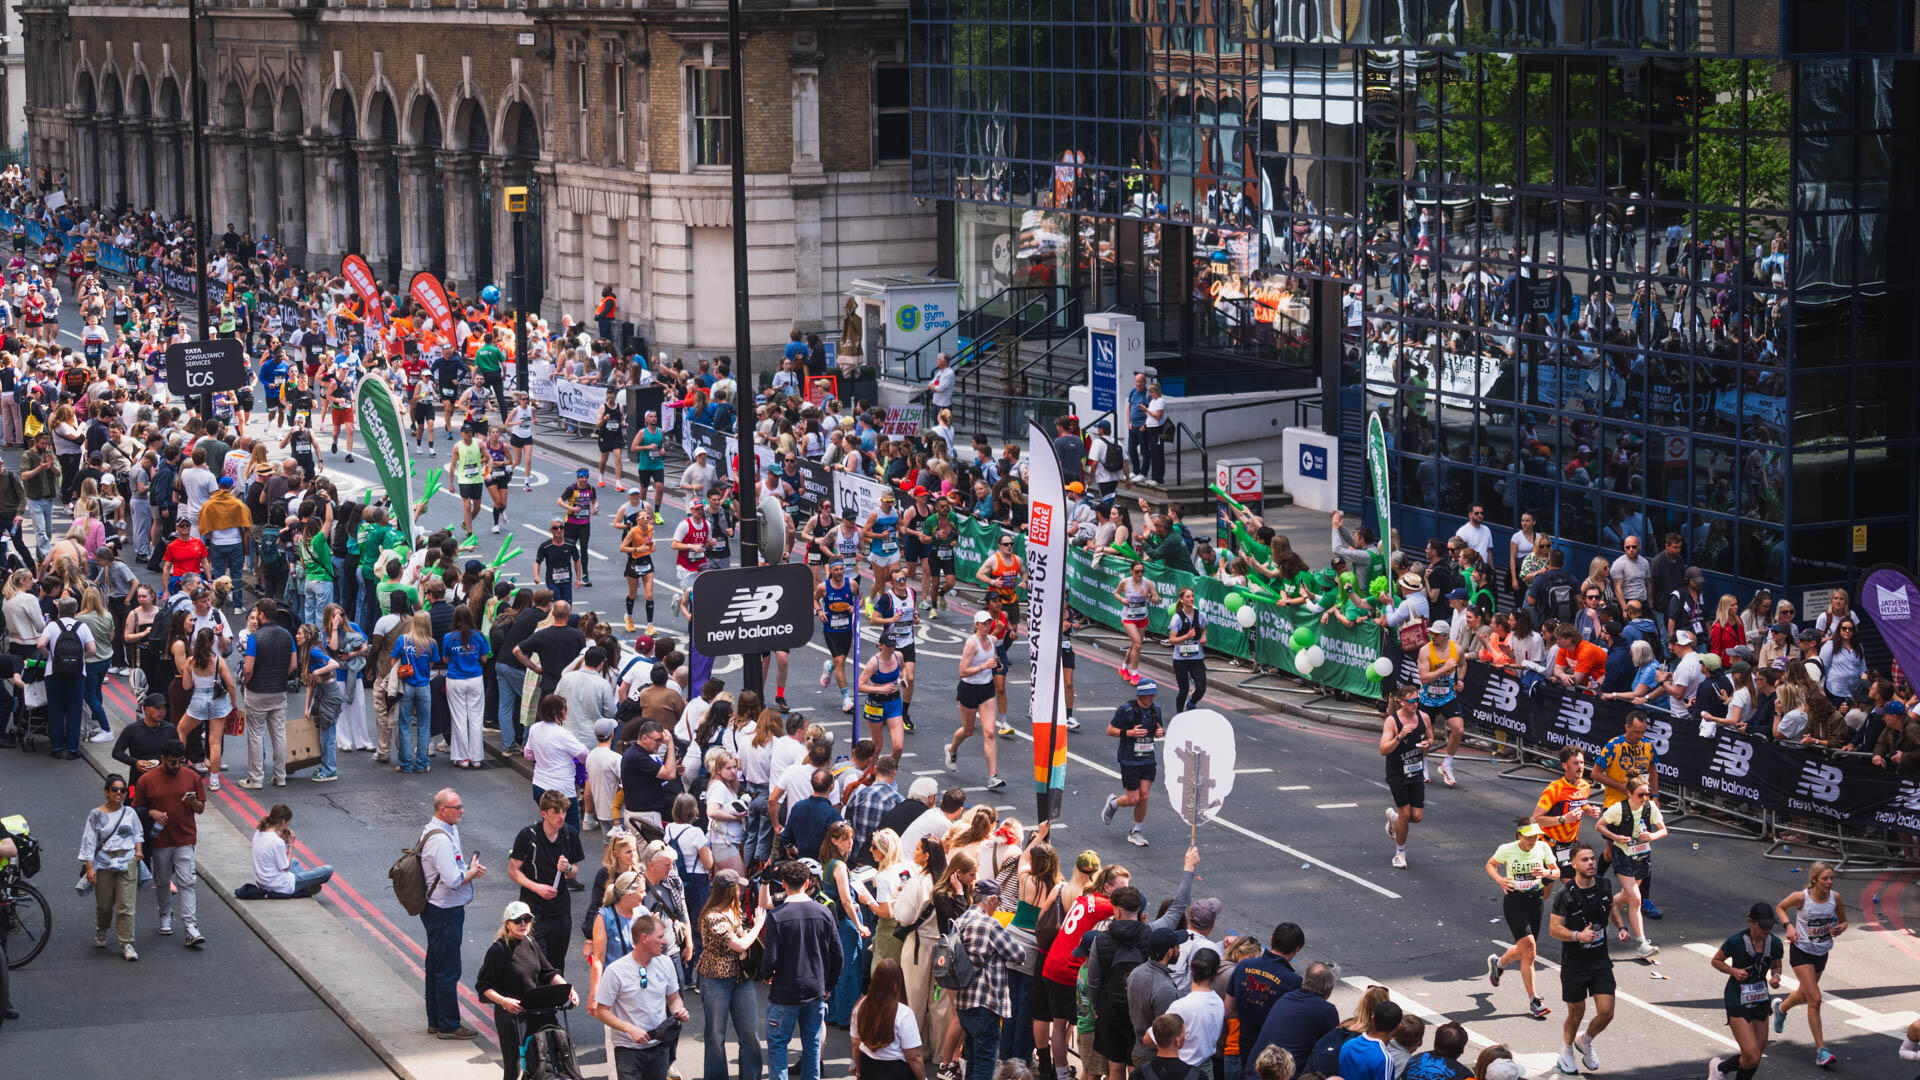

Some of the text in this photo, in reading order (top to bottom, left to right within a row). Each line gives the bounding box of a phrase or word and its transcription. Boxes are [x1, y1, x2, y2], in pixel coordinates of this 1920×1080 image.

[924, 311, 944, 321] gym
[924, 320, 950, 331] group
[1128, 338, 1140, 351] 10
[185, 352, 225, 360] CONSULTANCY
[186, 370, 214, 387] tcs
[364, 397, 404, 479] MACMILLAN
[376, 438, 397, 478] SUPPORT
[1032, 506, 1041, 540] FOR A
[1038, 508, 1050, 542] CURE
[1036, 553, 1048, 583] UK
[707, 624, 793, 642] new balance
[1320, 635, 1376, 660] MACMILLAN
[1473, 709, 1527, 733] new balance
[1547, 731, 1601, 755] new balance
[1621, 744, 1646, 756] ANDY
[1656, 763, 1679, 778] ance
[1702, 775, 1759, 800] new balance
[1788, 797, 1812, 812] new
[1875, 811, 1896, 823] new
